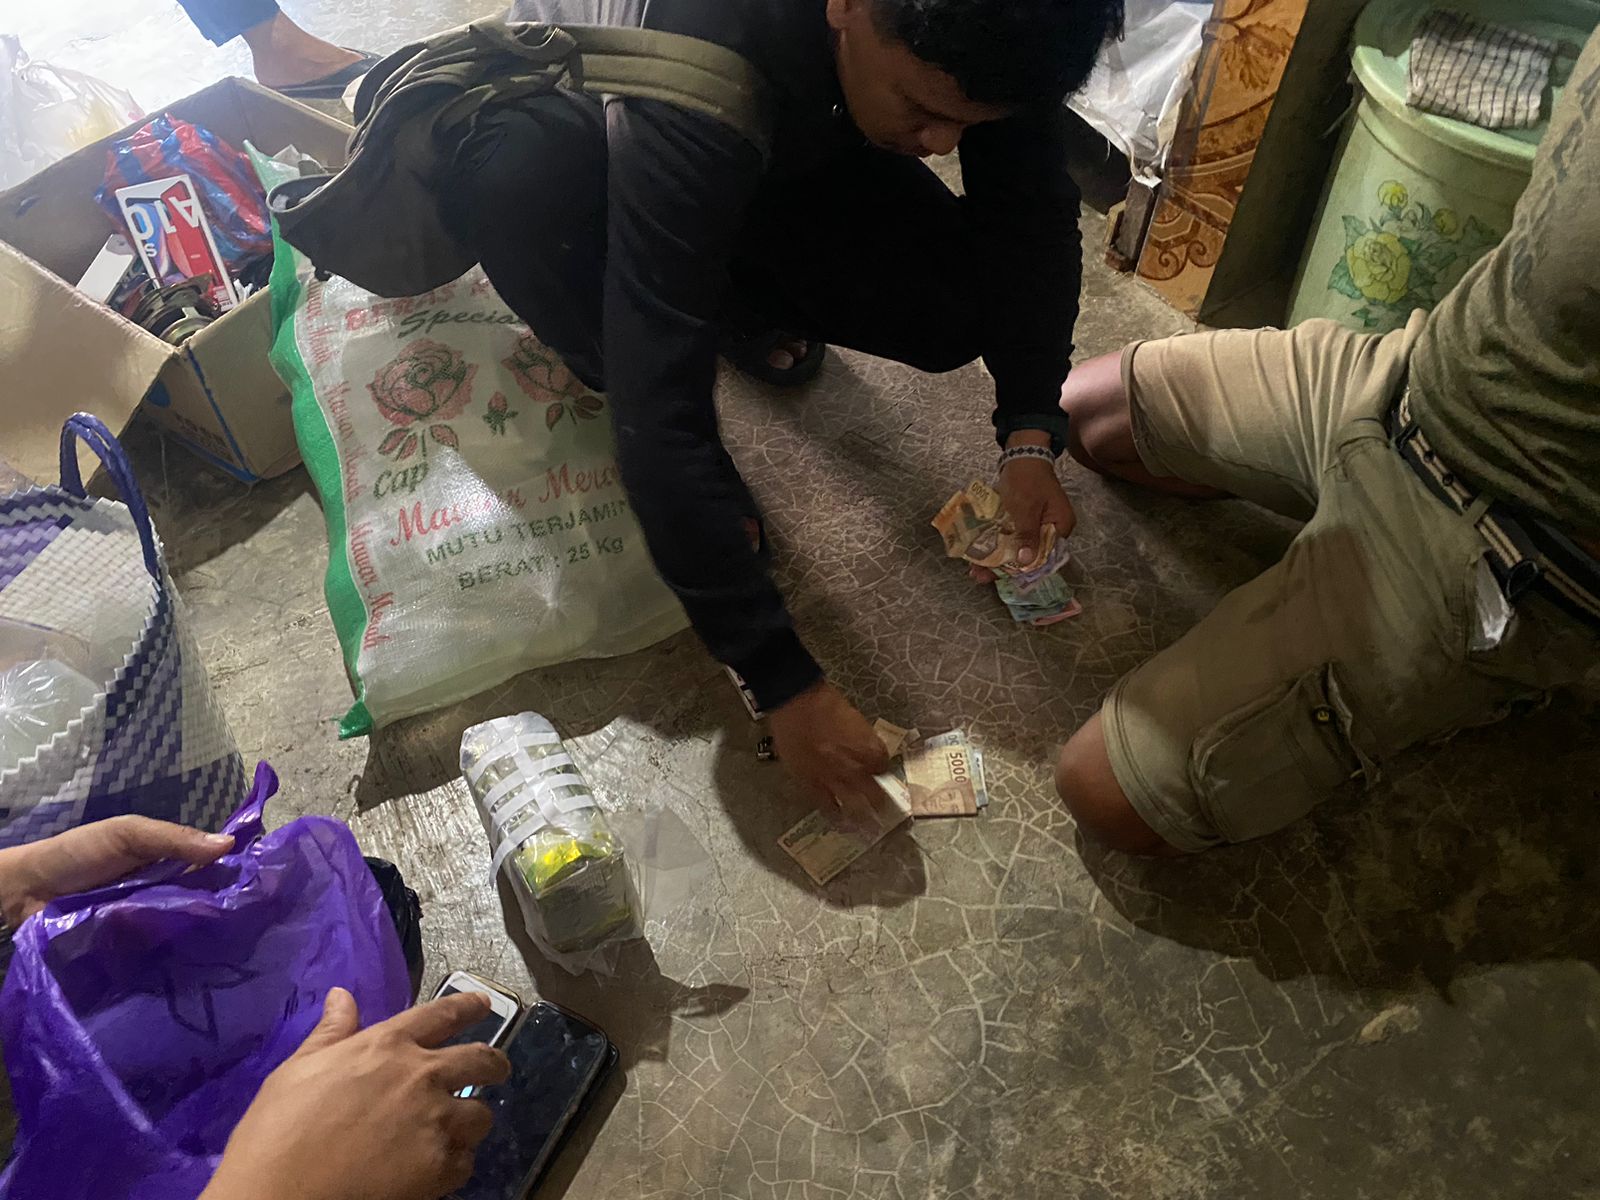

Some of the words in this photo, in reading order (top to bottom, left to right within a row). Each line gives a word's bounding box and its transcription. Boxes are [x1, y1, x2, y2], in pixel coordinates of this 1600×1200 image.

[125, 196, 199, 241] A10
[538, 462, 620, 503] Mera
[350, 521, 379, 588] Mawar
[426, 525, 501, 565] MUTU
[457, 555, 546, 591] BERAT
[566, 542, 591, 564] 25
[363, 590, 394, 651] Merah
[949, 751, 967, 783] 5000
